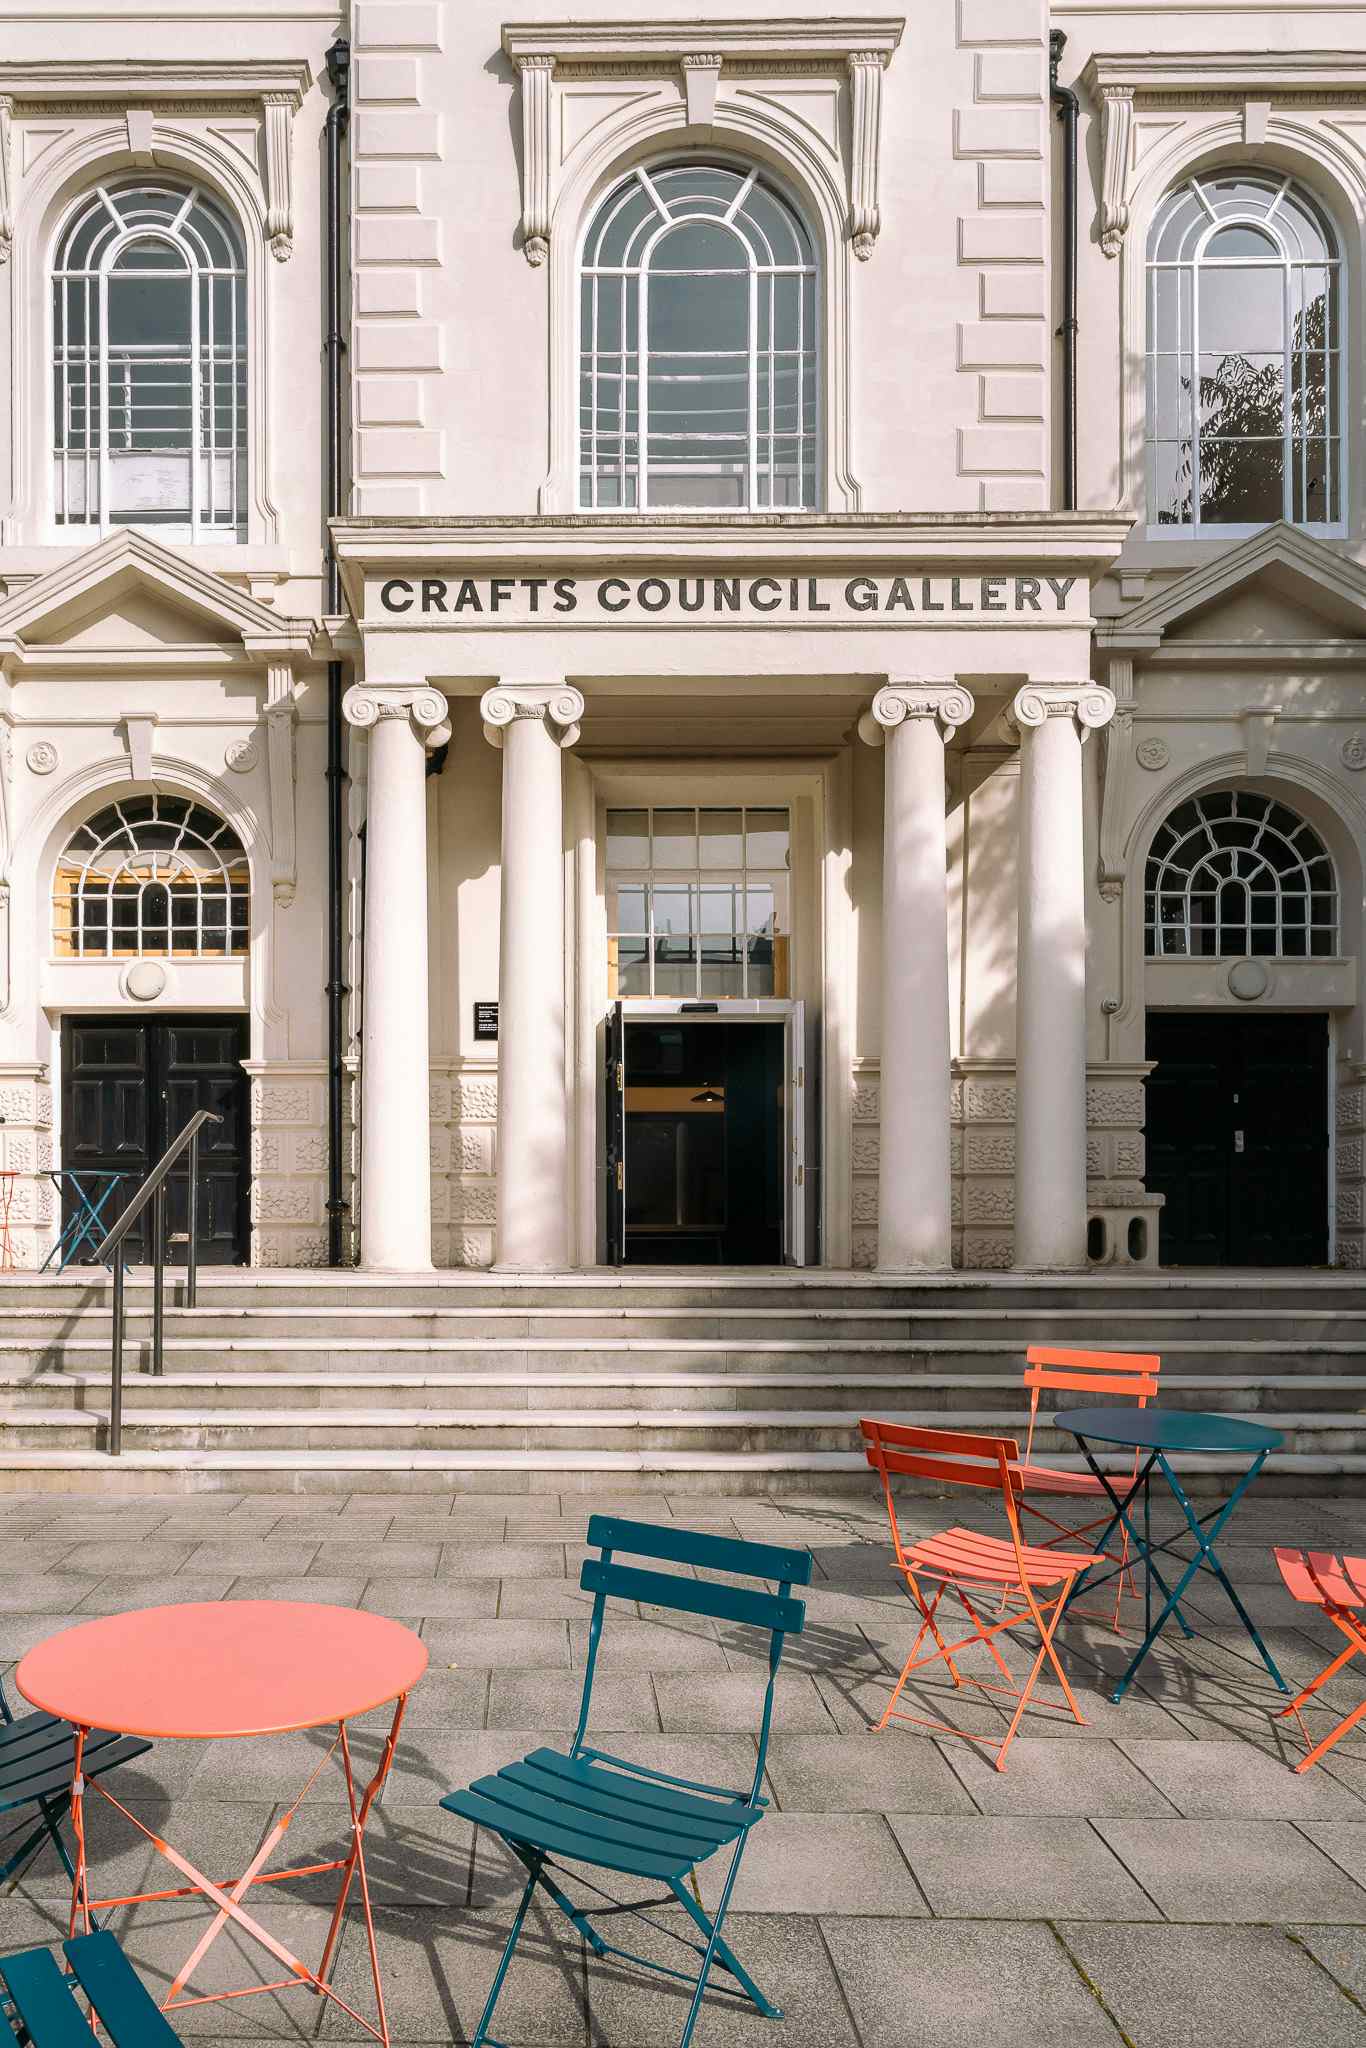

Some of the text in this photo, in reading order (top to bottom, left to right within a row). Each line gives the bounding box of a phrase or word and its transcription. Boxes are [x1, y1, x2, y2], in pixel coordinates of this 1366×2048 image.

[380, 577, 1077, 613] CRAFTS COUNCIL GALLERY
